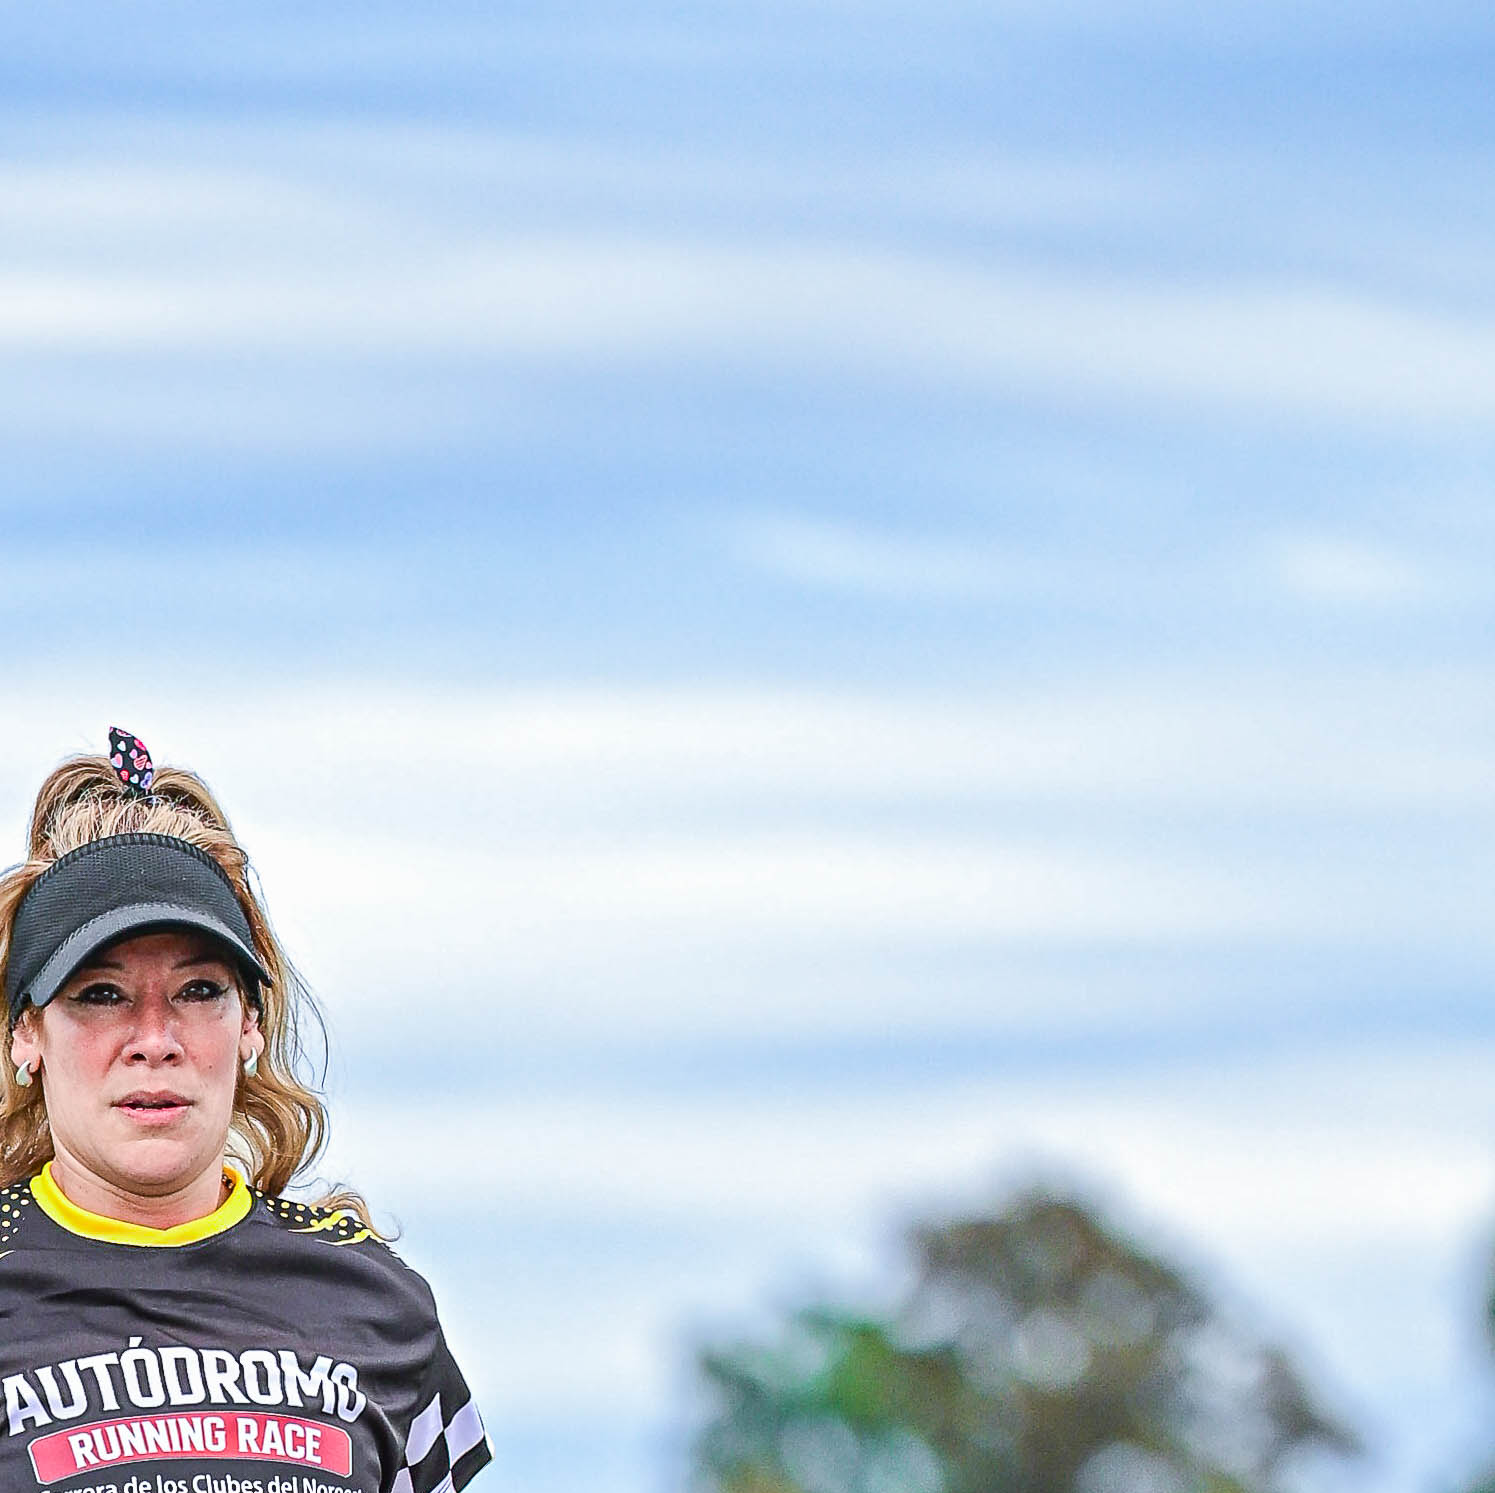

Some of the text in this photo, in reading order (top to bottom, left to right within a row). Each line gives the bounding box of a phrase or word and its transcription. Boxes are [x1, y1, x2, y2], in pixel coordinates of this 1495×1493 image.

[2, 1337, 367, 1436] AUTÓDROMO
[68, 1416, 322, 1469] RUNNING RACE
